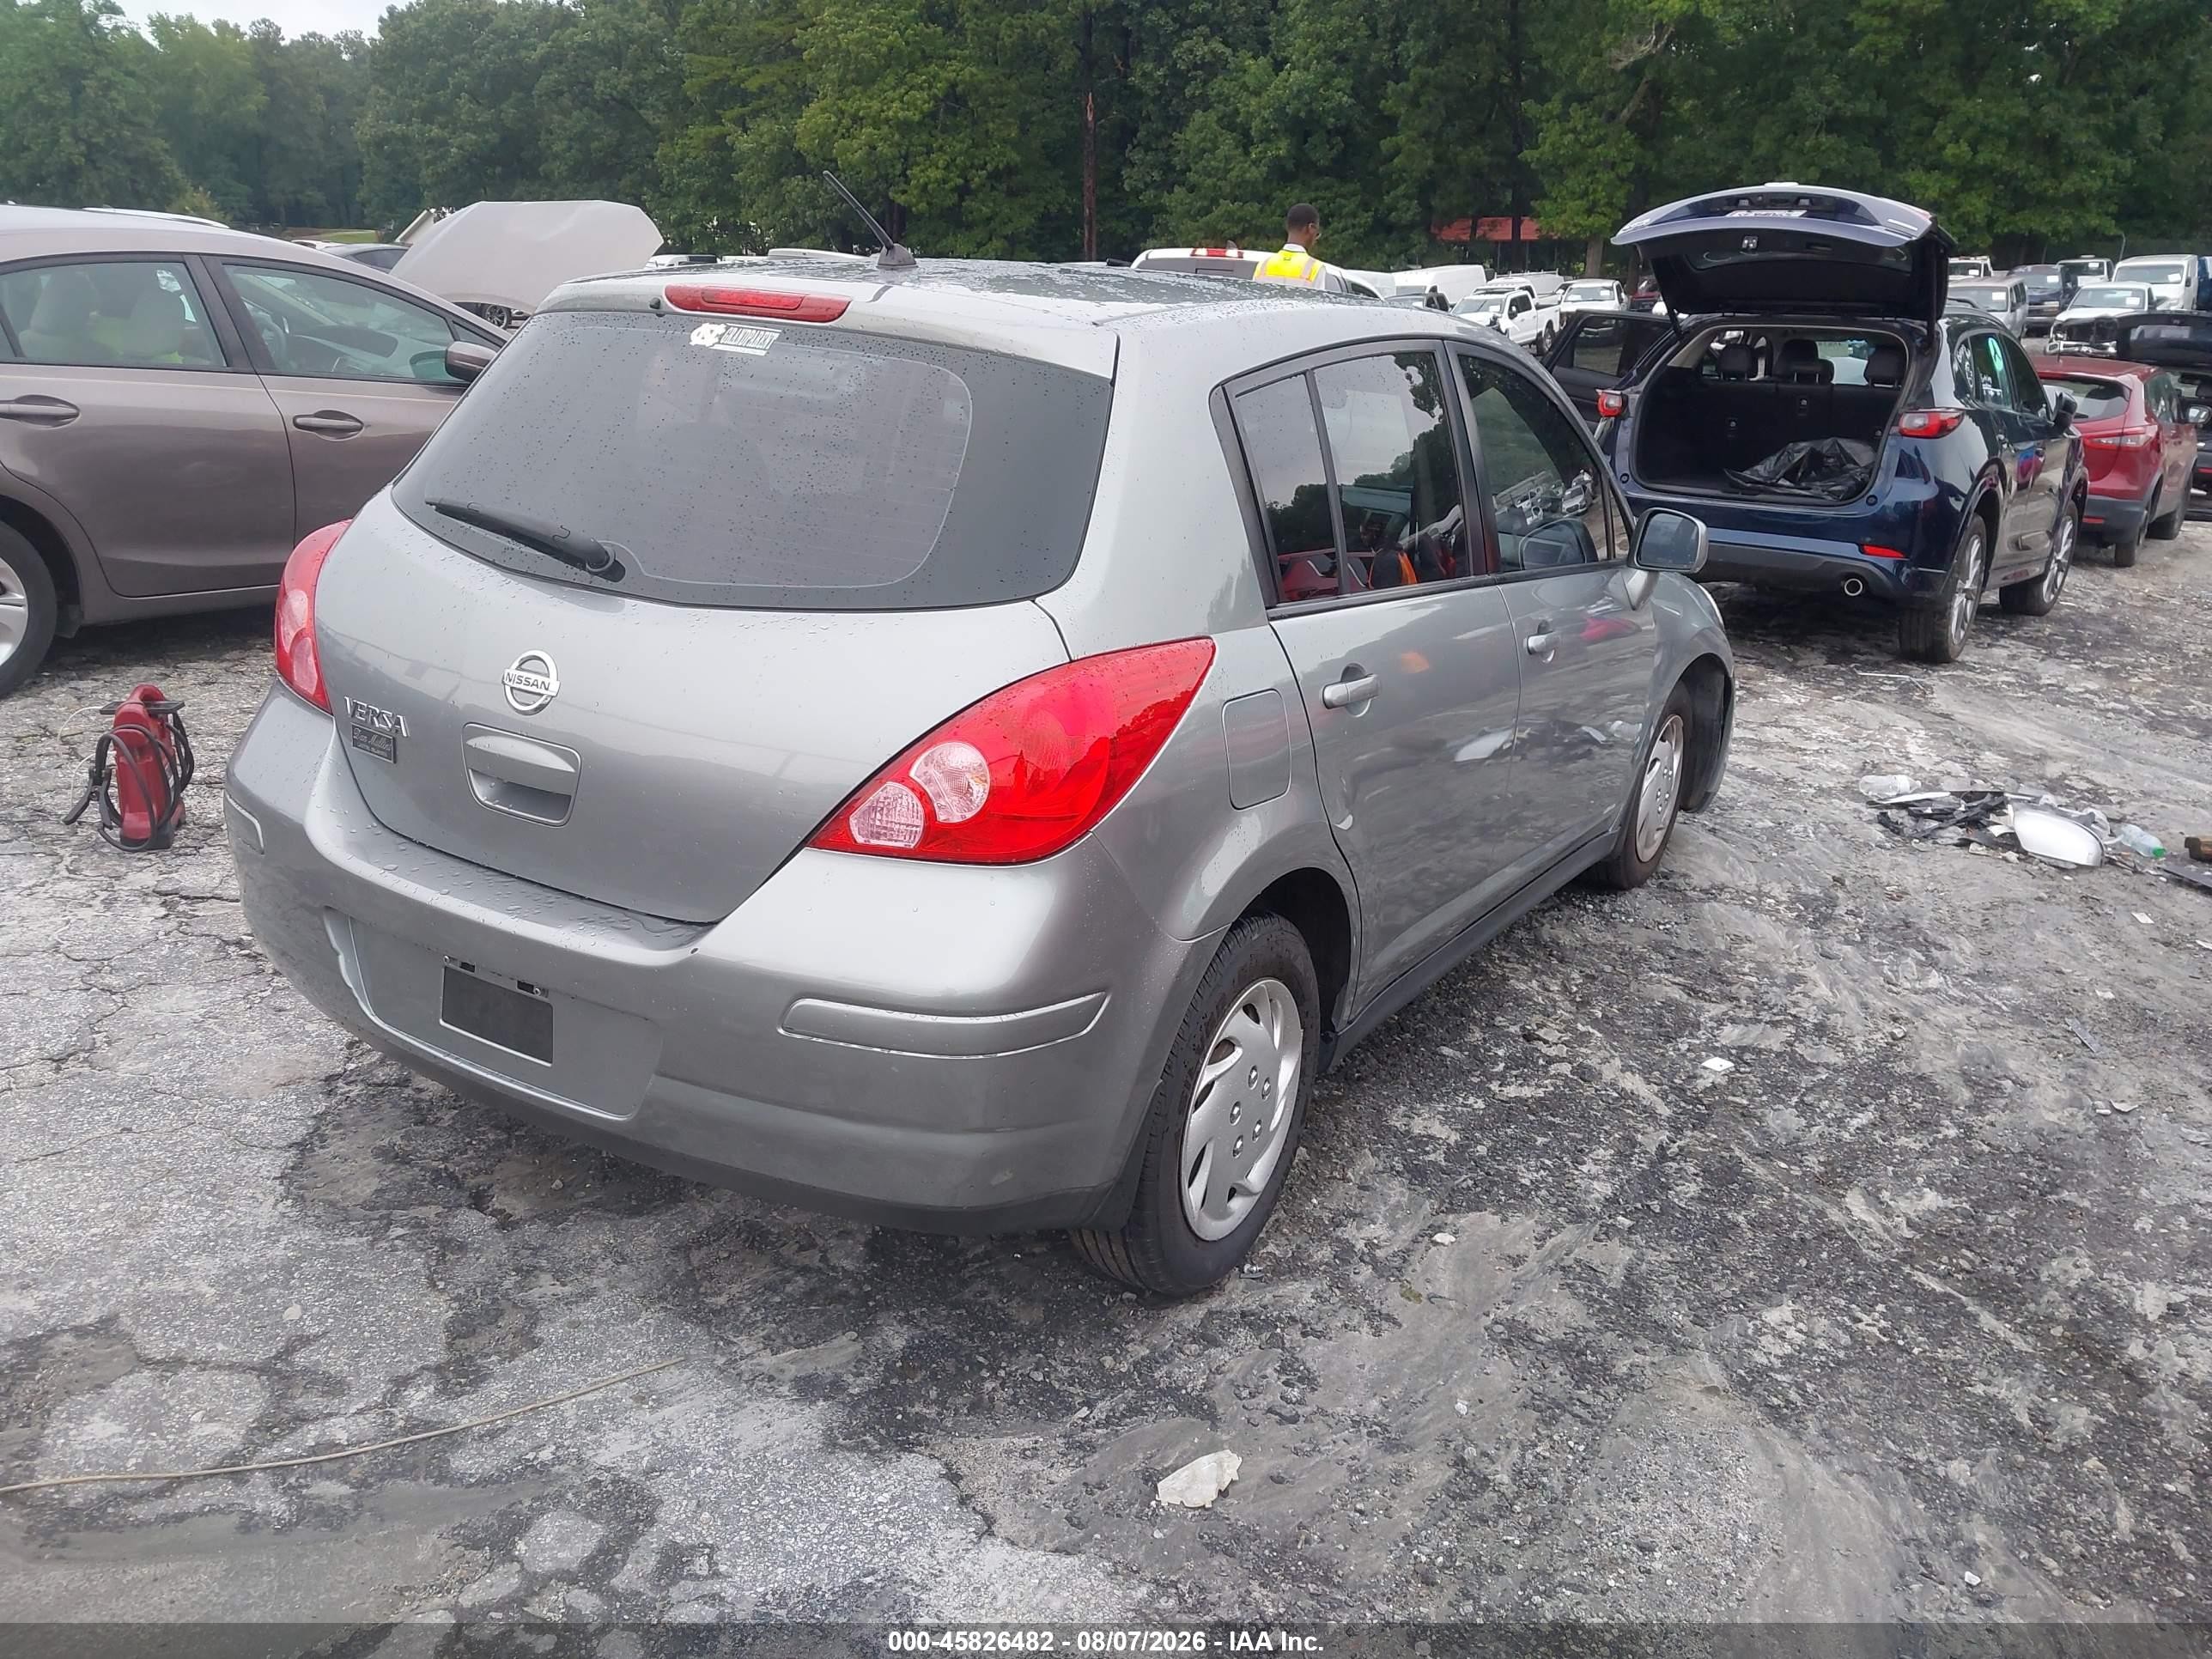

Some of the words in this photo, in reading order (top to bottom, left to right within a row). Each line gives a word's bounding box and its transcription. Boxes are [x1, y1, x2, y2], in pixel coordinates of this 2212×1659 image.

[720, 327, 781, 349] GRANDPARENT
[504, 671, 551, 691] NISSAN
[344, 696, 410, 738] VERSA
